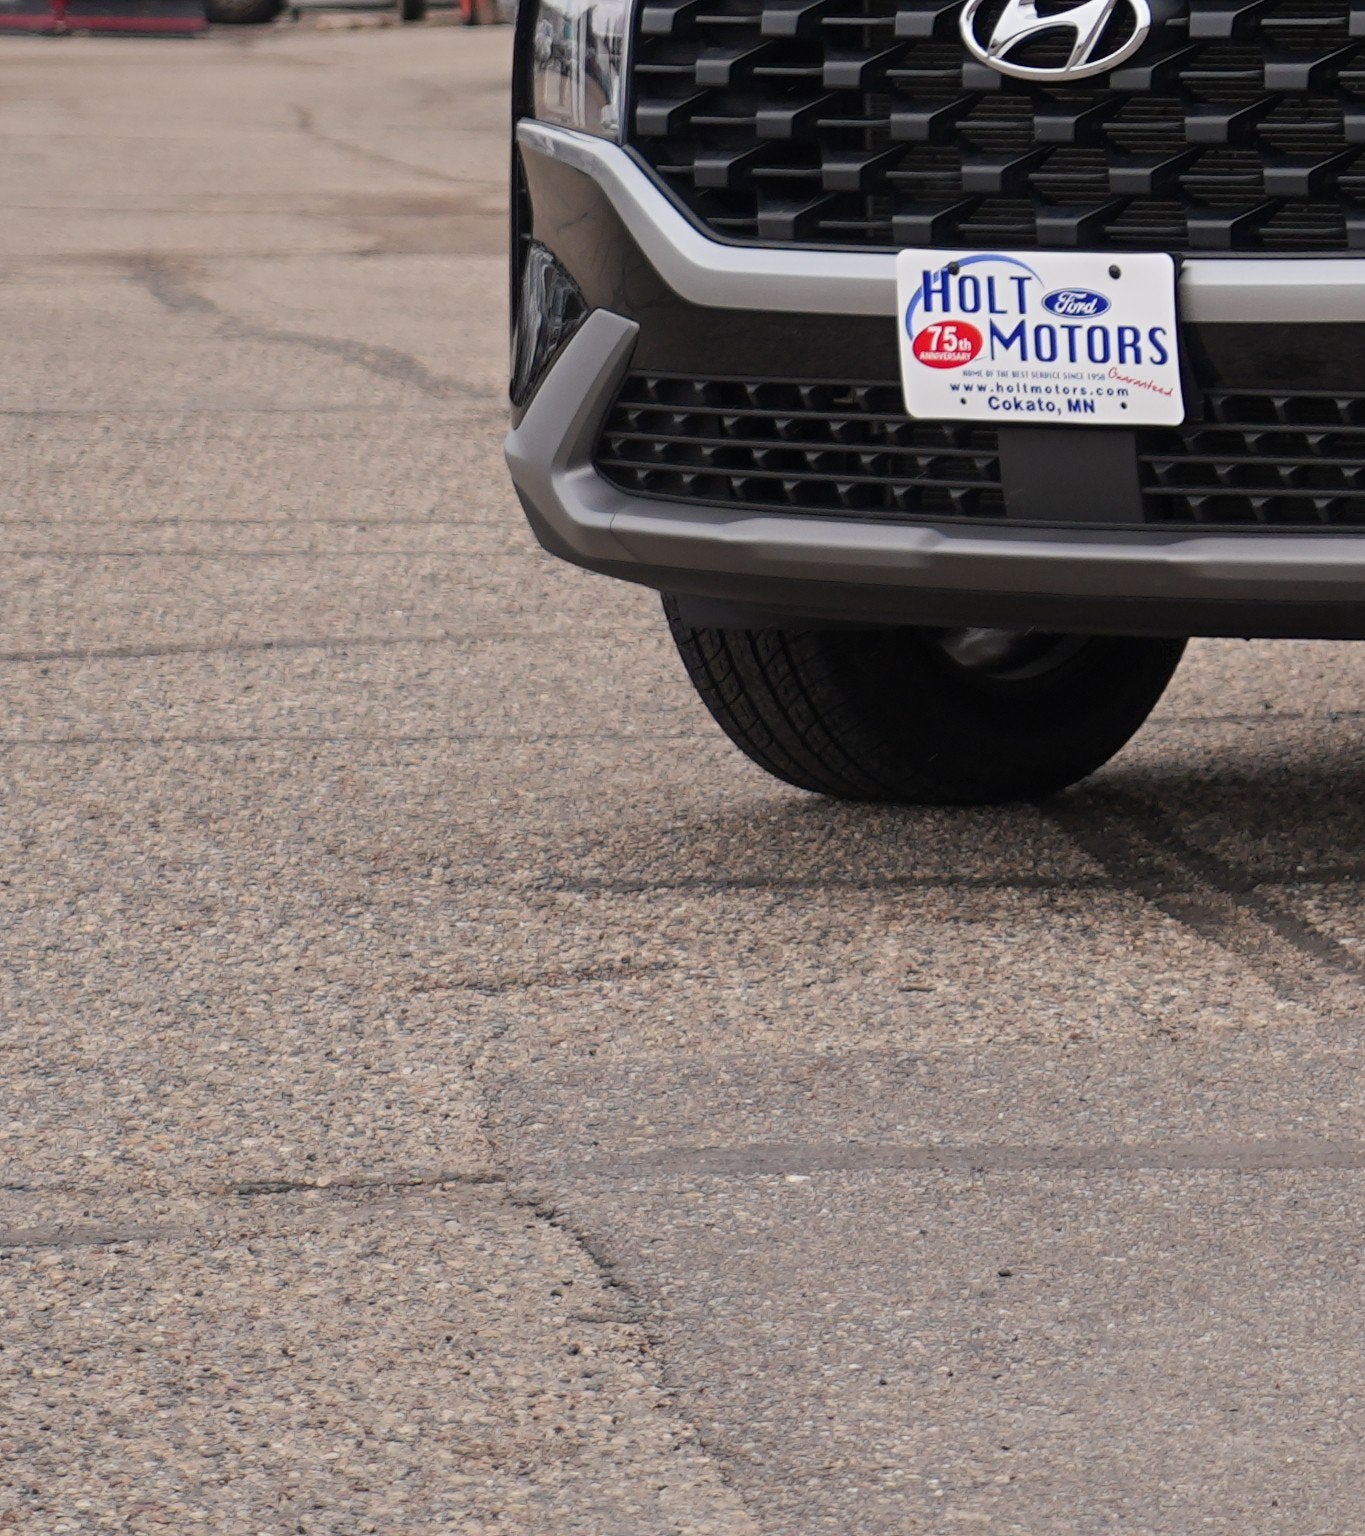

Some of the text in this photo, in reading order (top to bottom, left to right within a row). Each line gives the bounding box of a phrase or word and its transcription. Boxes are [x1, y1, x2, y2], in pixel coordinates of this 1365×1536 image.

[922, 270, 1032, 314] HOLT
[1052, 290, 1100, 315] Ford
[927, 326, 972, 352] 75th
[990, 318, 1168, 365] MOTORS
[920, 350, 971, 361] ANNIVERSARY
[962, 369, 982, 378] HOME
[985, 369, 994, 378] OF
[996, 370, 1009, 378] THE
[1012, 370, 1029, 378] BEST
[1031, 371, 1060, 379] SERVICE
[1063, 372, 1083, 380] SINCE
[1108, 366, 1174, 397] Guaranteed
[950, 382, 1129, 396] www.holtmotors.com
[987, 395, 1095, 415] Cokato, MN
